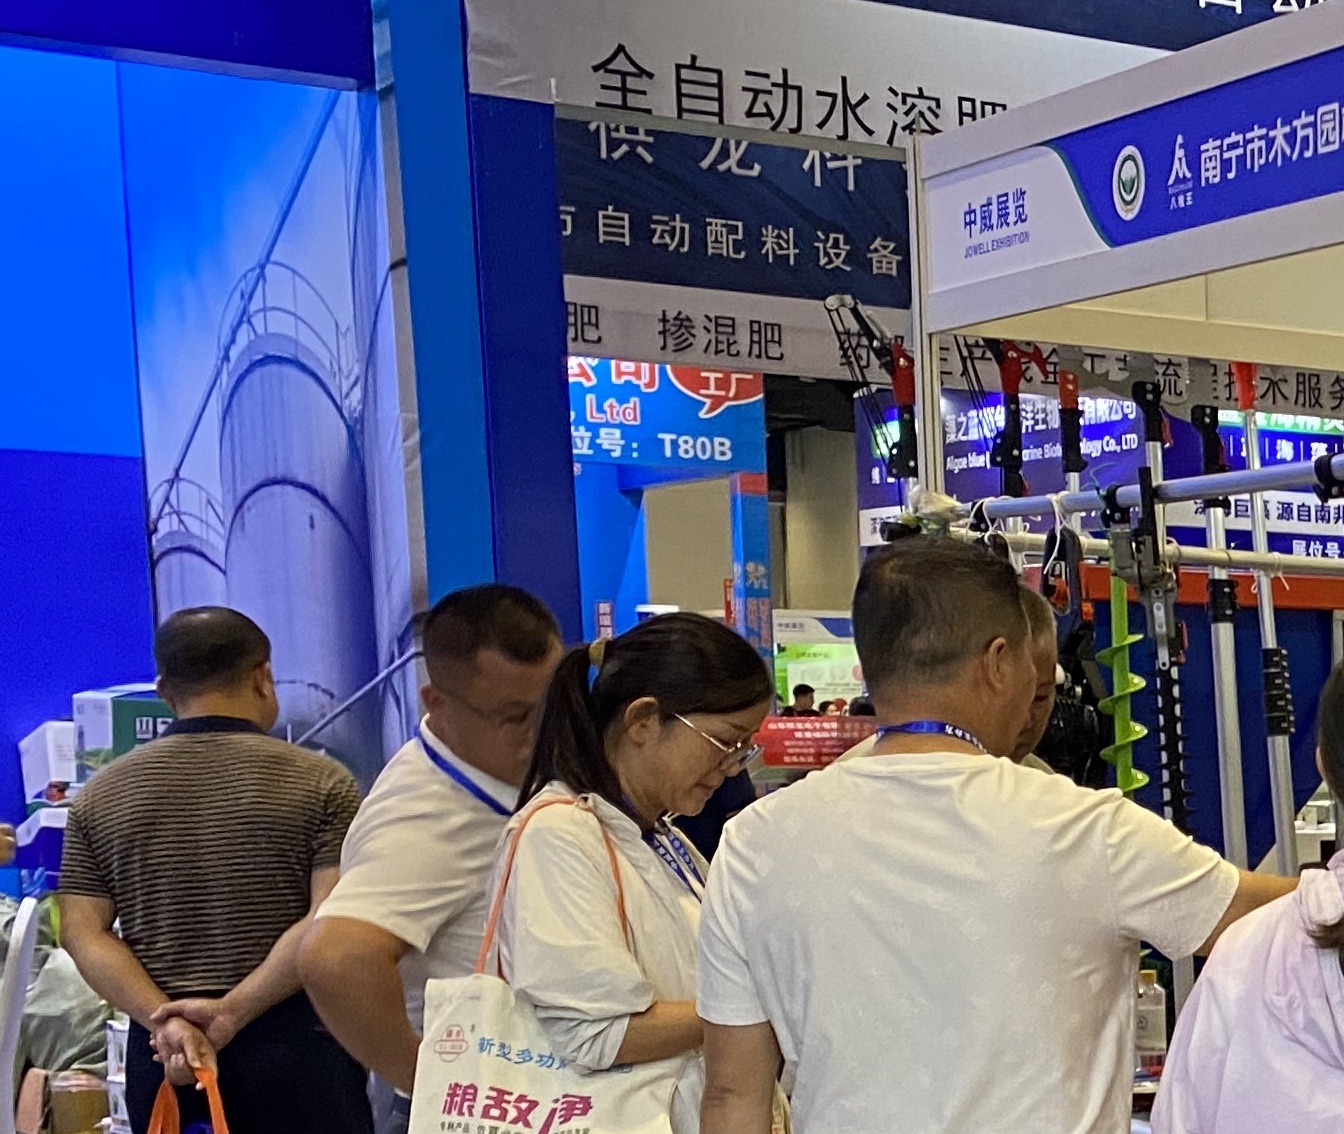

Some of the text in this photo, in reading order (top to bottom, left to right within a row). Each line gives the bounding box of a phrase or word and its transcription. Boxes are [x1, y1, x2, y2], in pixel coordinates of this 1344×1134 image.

[963, 187, 1028, 239] 中威展览
[658, 308, 784, 362] 掺混肥
[700, 370, 754, 398] 工厂
[585, 395, 641, 425] Ltd
[657, 432, 733, 462] T80B
[1121, 432, 1138, 450] LTD
